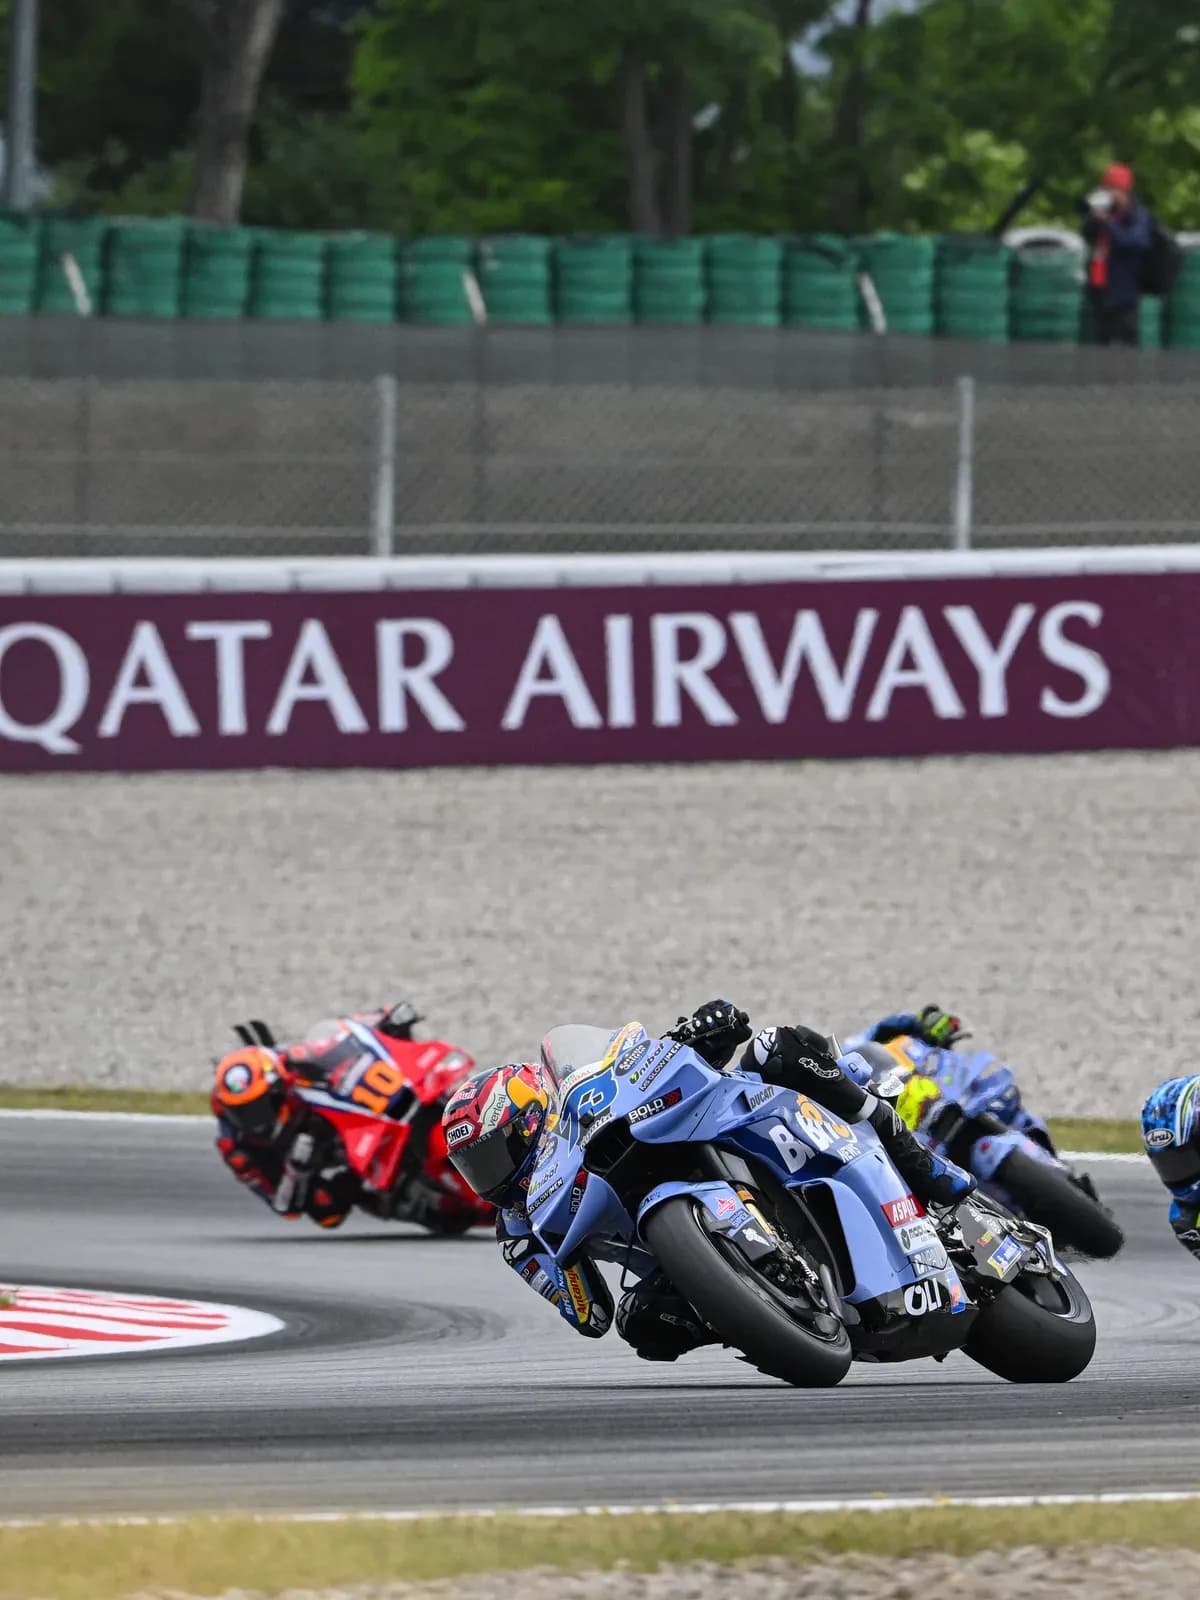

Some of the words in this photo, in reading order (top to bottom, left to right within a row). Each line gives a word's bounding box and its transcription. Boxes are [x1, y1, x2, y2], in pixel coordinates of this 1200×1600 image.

[0, 618, 463, 754] QATAR
[501, 601, 1110, 730] AIRWAYS
[352, 1060, 405, 1115] 10
[750, 1086, 775, 1109] DUCATI
[628, 1098, 663, 1120] BOLD
[448, 1125, 469, 1142] SHOEI
